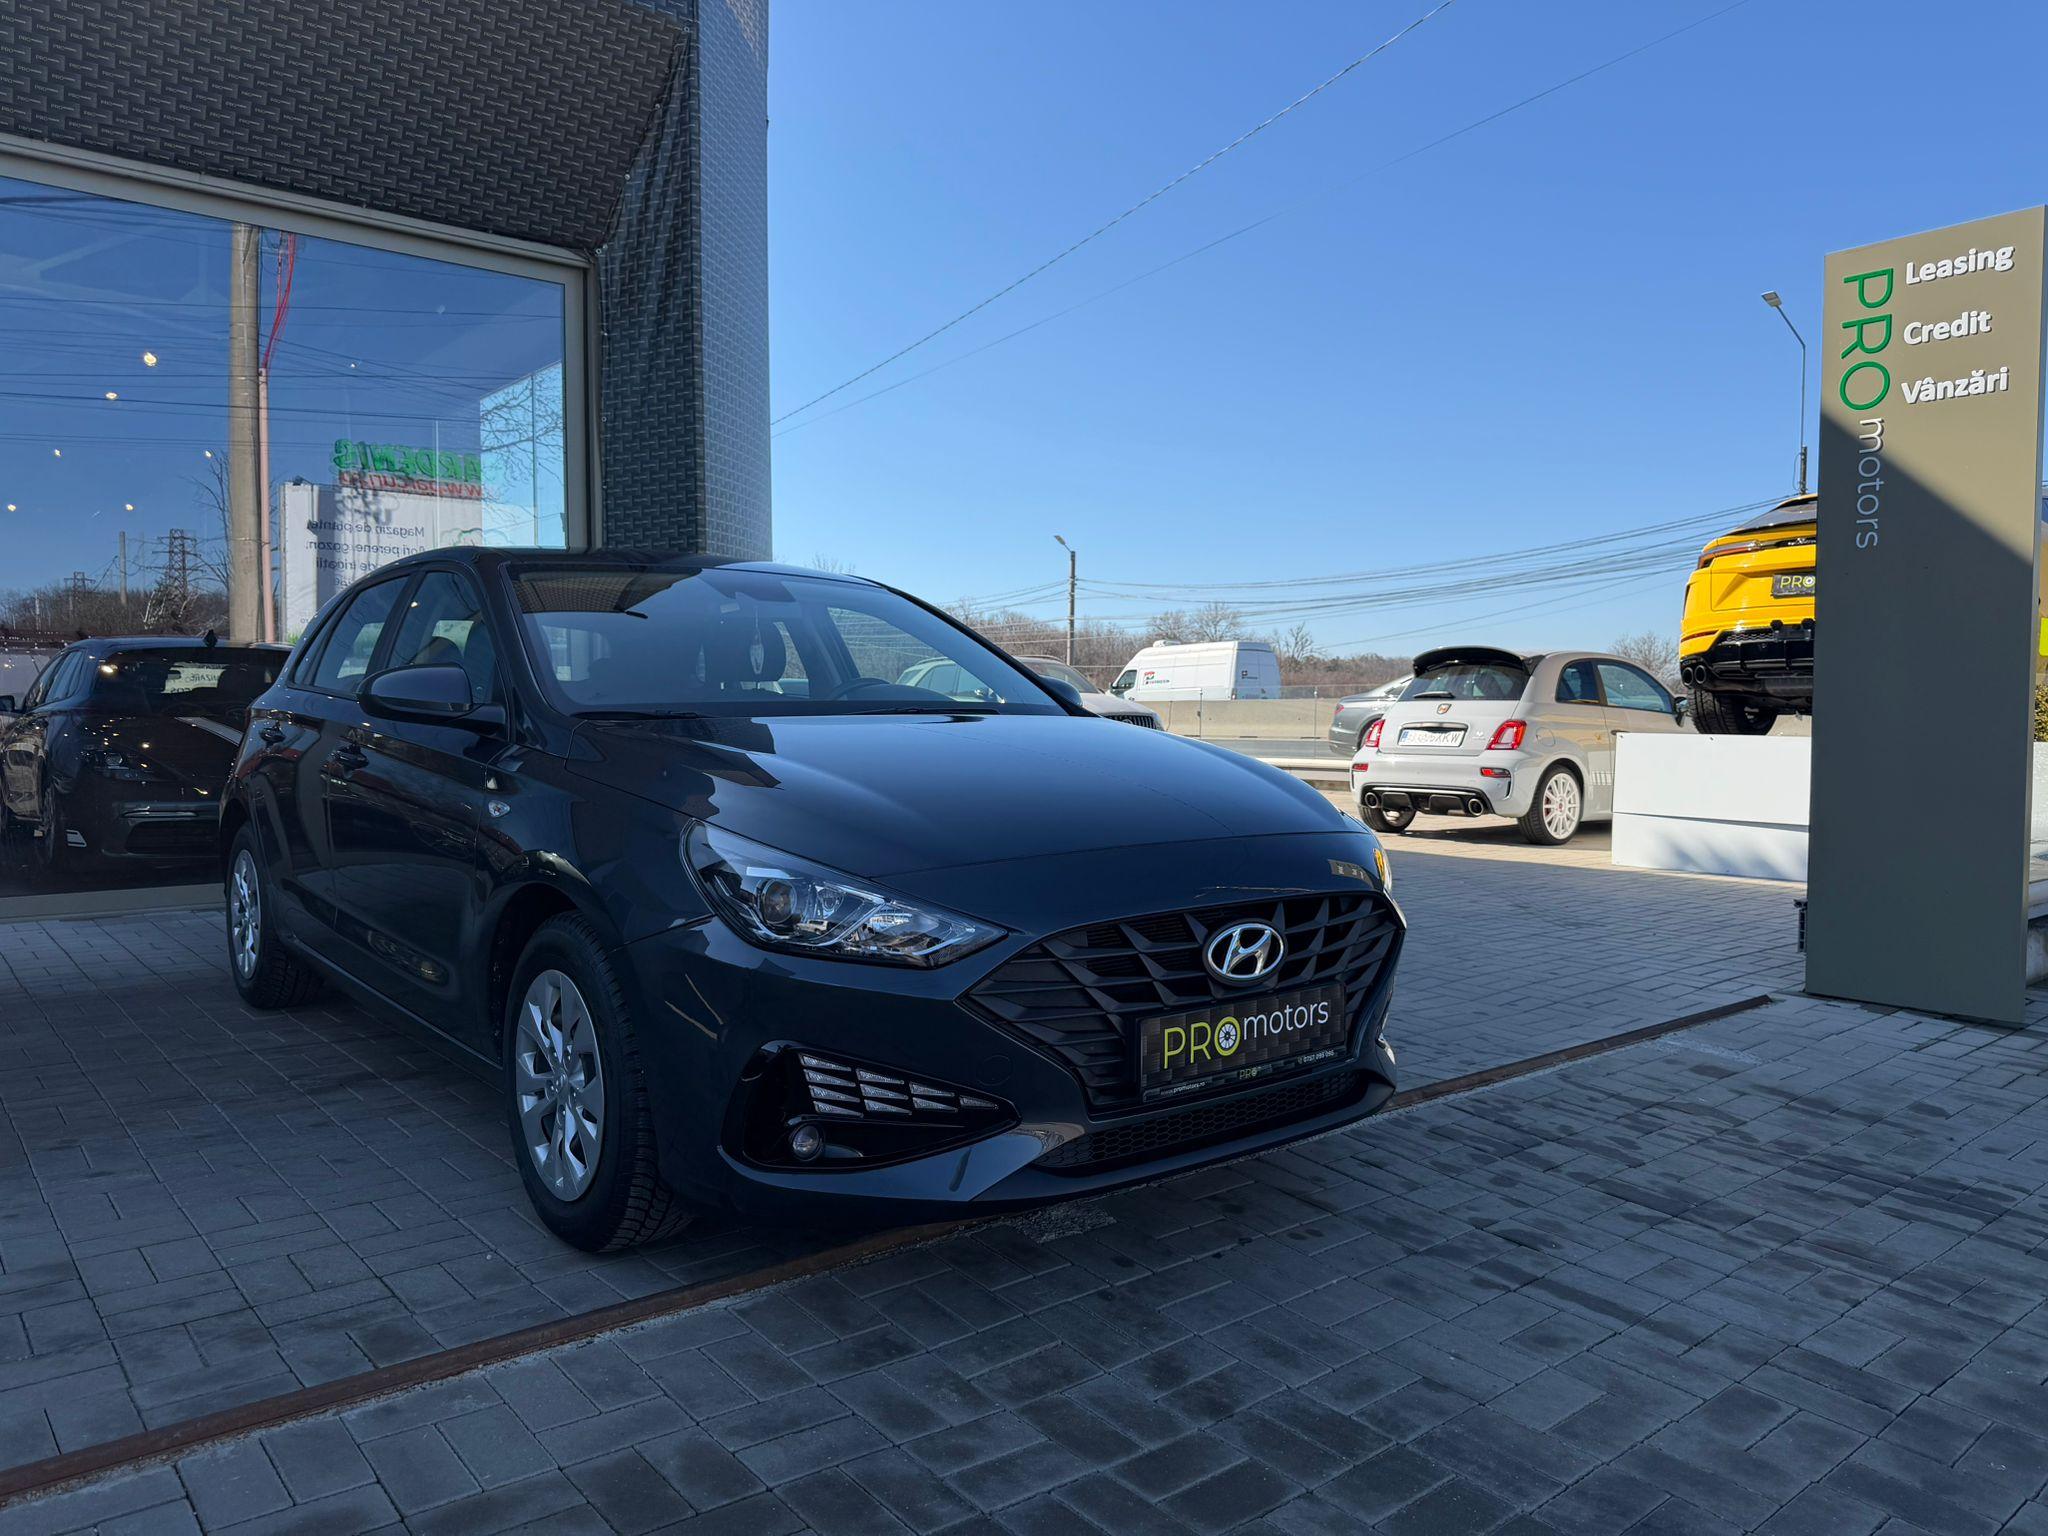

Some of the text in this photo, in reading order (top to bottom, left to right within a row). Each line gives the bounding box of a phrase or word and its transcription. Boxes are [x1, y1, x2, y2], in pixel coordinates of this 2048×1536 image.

[1905, 246, 2015, 286] Leasing
[1903, 310, 1992, 345] Credit
[1901, 366, 2010, 405] Vânzări
